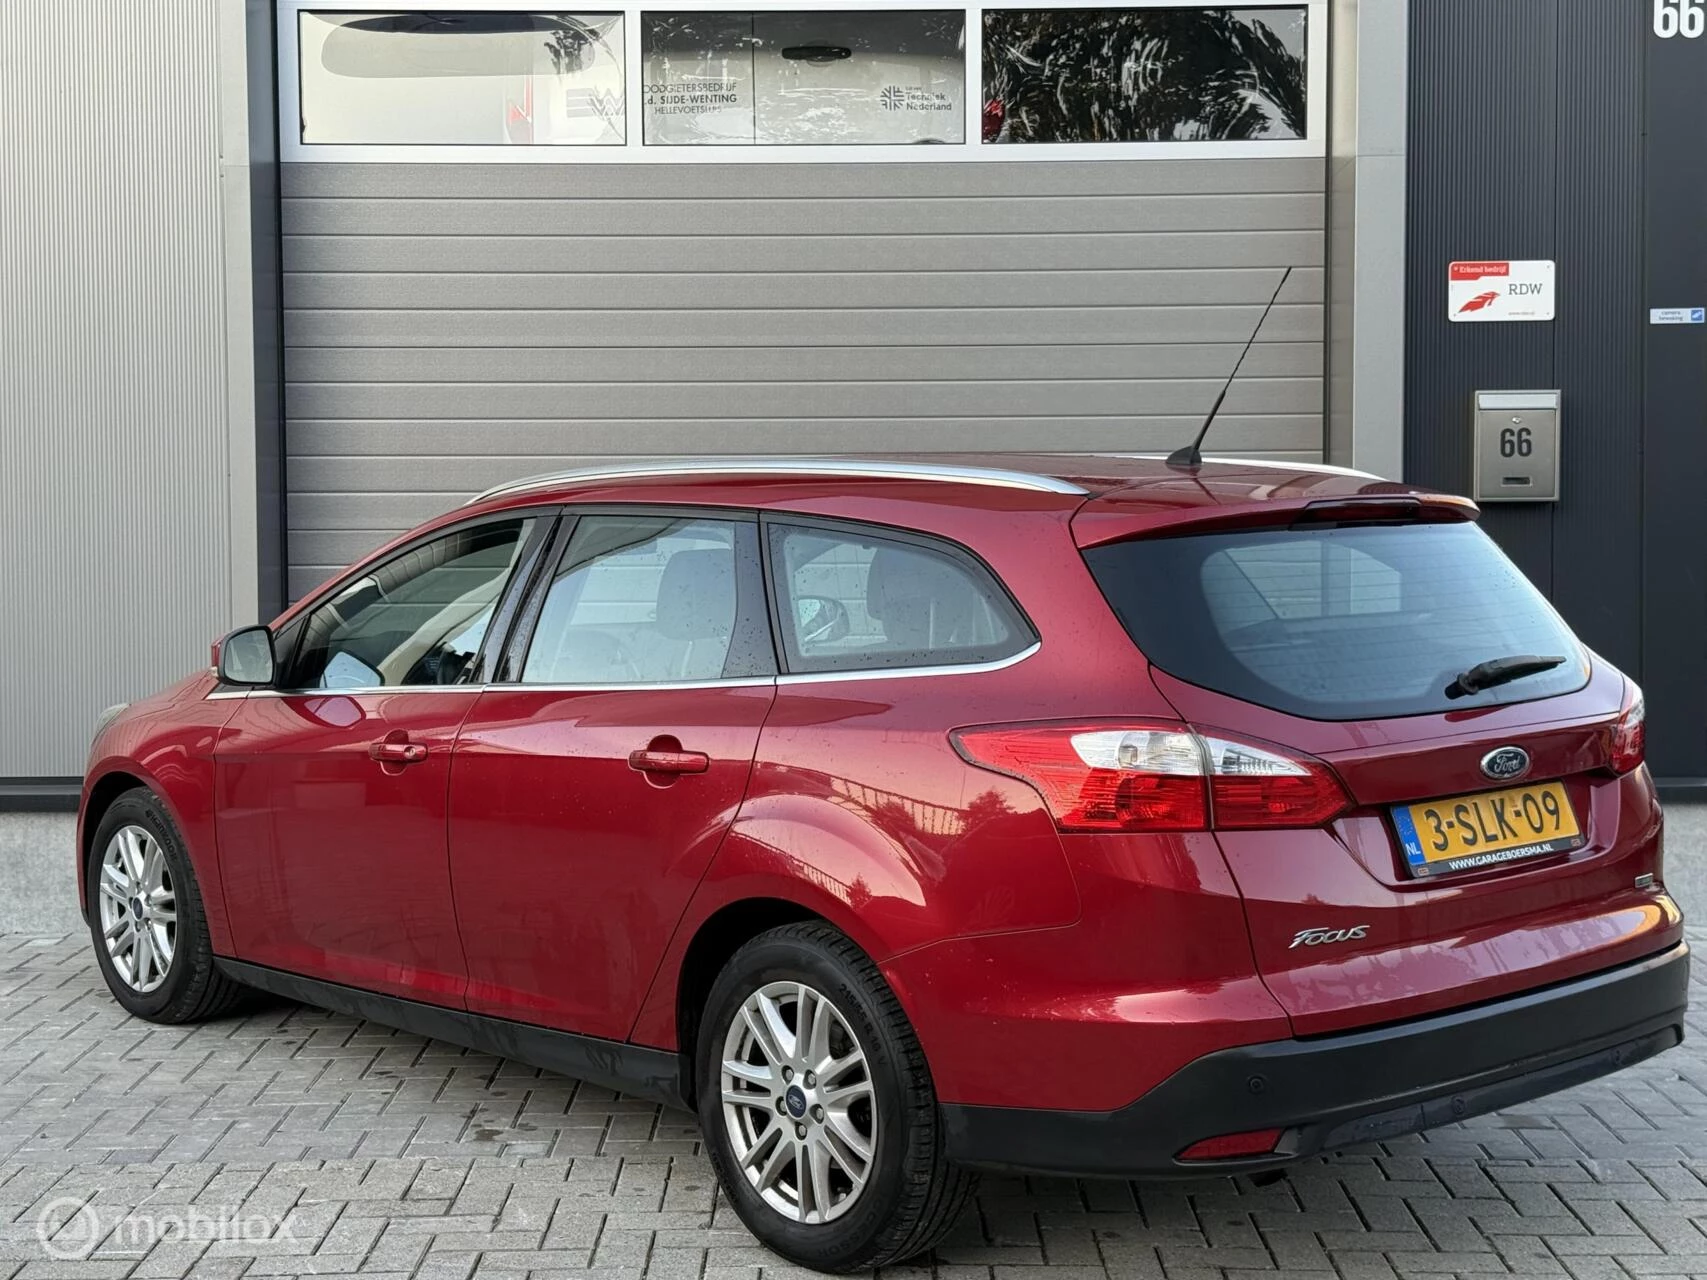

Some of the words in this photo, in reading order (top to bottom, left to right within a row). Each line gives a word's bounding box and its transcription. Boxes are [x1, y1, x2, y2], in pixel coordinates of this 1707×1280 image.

[1653, 0, 1704, 38] 66
[906, 102, 952, 110] Nederland
[1508, 283, 1543, 295] RDW
[1500, 427, 1532, 457] 66
[1494, 753, 1521, 772] Ford
[1424, 791, 1560, 851] 3-SLK-09
[1405, 842, 1421, 856] NL
[1449, 843, 1554, 870] WWW.GARAGEBOERSMA.NL
